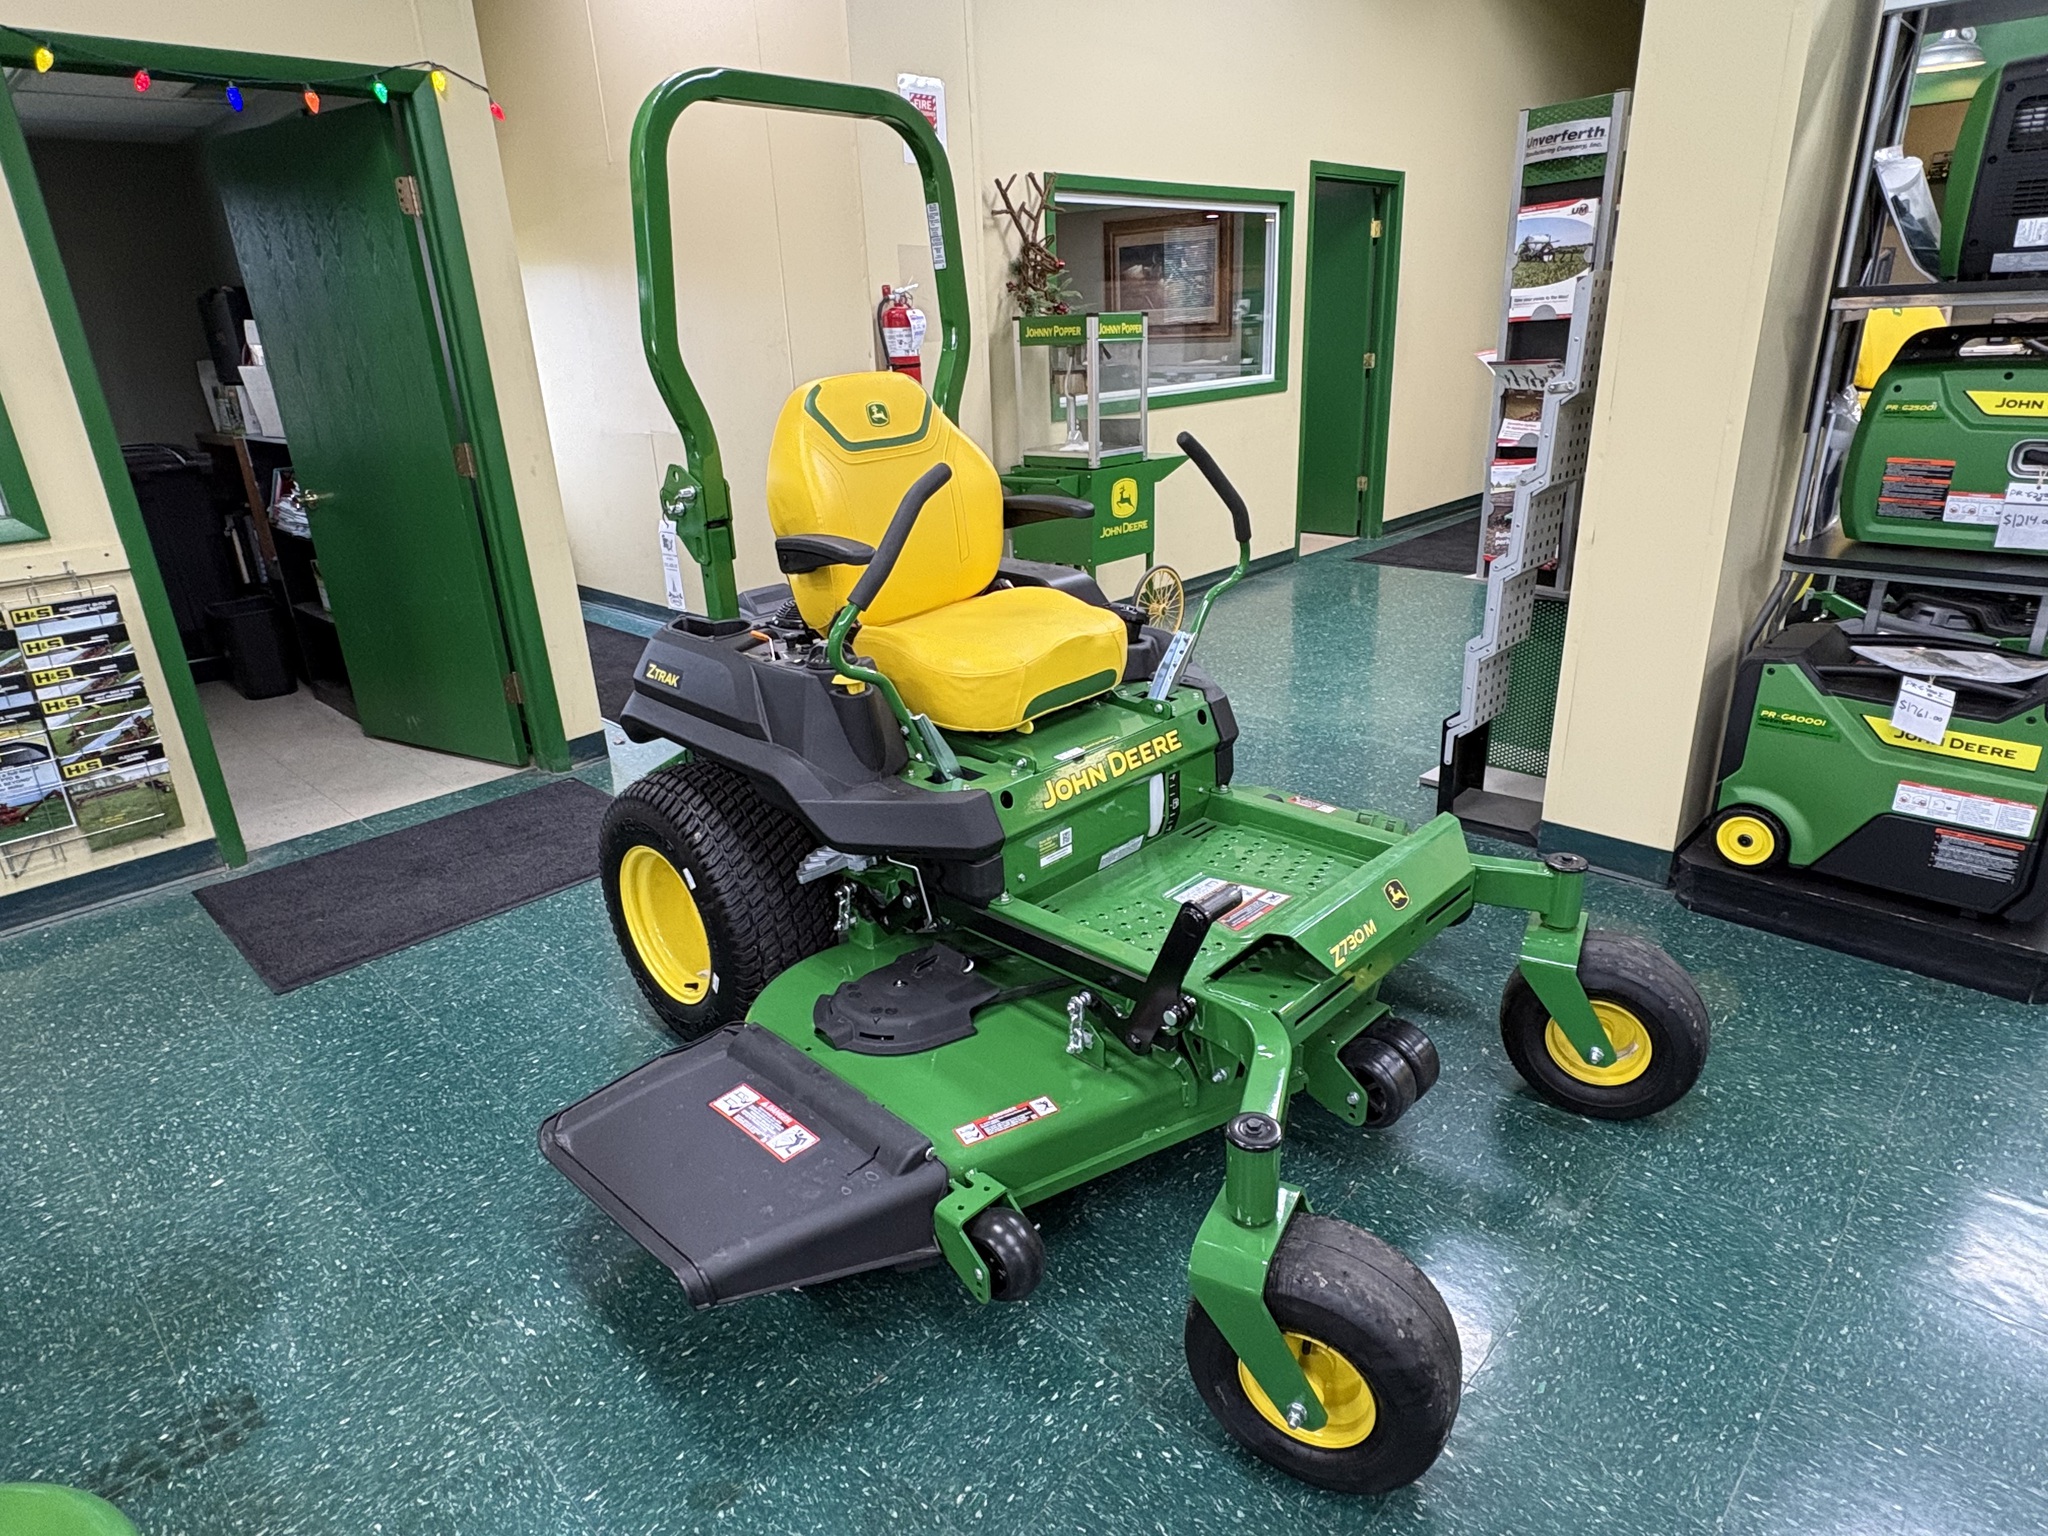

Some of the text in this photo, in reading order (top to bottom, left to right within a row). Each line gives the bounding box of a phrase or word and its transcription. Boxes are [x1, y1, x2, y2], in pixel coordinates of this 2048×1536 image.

[913, 98, 933, 110] FIRE
[1526, 126, 1606, 149] Unverferth
[1025, 325, 1082, 338] JOHNNY POPPER
[1098, 322, 1143, 335] JOHNNY POPPER
[1995, 397, 2044, 410] JOHN
[2003, 513, 2048, 528] $1214.0
[1099, 519, 1149, 539] JOHN DEERE
[15, 608, 50, 622] H&S
[26, 639, 61, 654] H&S
[36, 669, 71, 684] H&S
[646, 663, 680, 688] ZTRAK
[45, 697, 80, 712] H&S
[1899, 700, 1943, 722] $1761.00
[1894, 731, 2017, 760] JO DEERE
[67, 761, 99, 776] H&S
[1042, 763, 1108, 810] JOHN
[1106, 729, 1182, 778] DEERE
